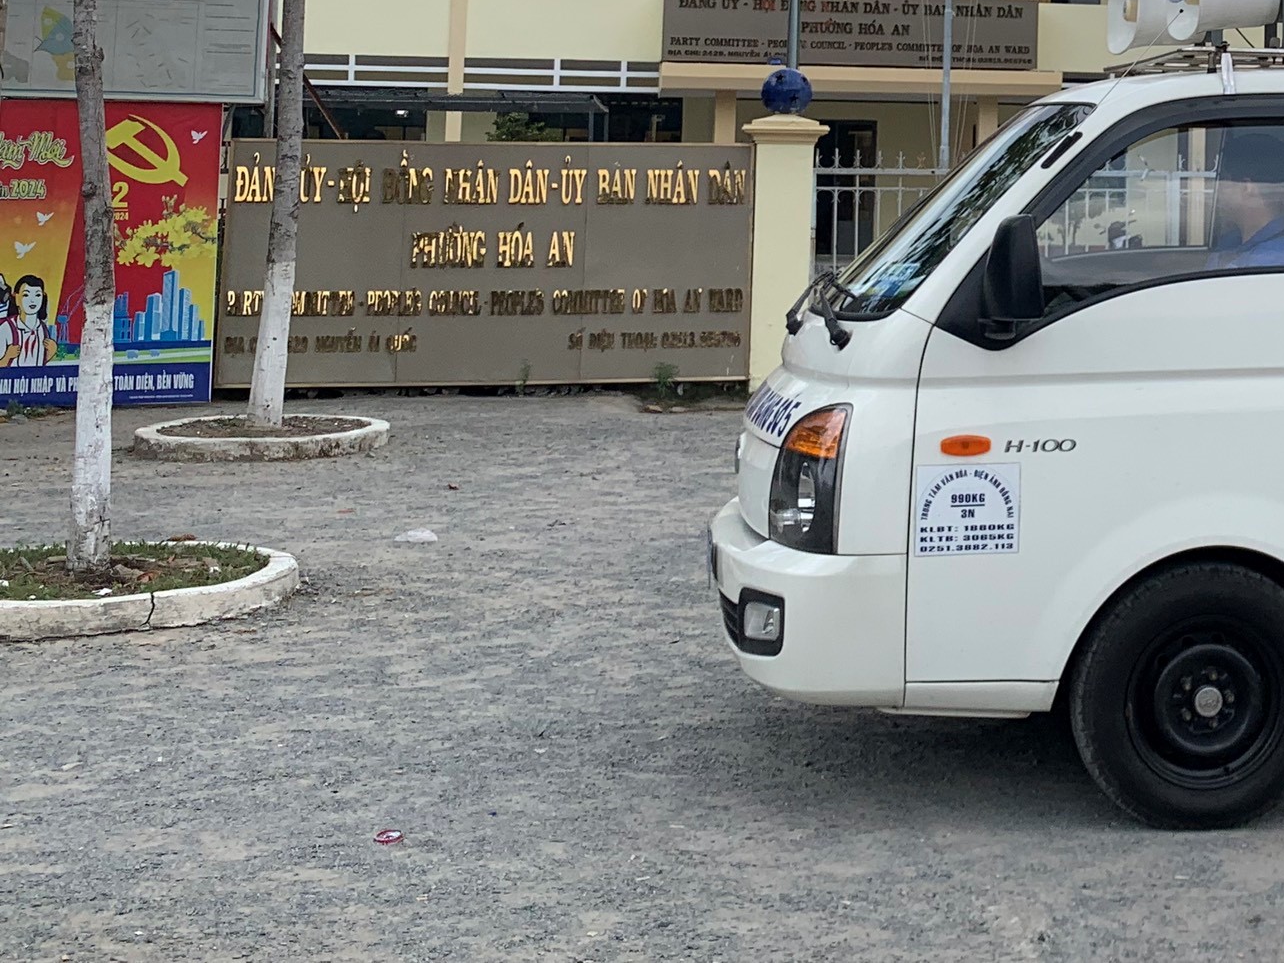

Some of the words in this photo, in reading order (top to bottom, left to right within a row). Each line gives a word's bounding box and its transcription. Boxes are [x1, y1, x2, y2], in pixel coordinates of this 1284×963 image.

[780, 0, 816, 13] ĐNG
[820, 0, 859, 13] NHÂN
[863, 0, 891, 15] DÂN
[902, 0, 919, 15] ỦY
[956, 4, 993, 18] NHÂN
[997, 6, 1024, 19] DÂN
[801, 18, 853, 34] PHƯỜNG
[858, 20, 885, 36] HÓA
[891, 24, 911, 36] AN
[670, 37, 700, 46] PARTY
[704, 38, 759, 48] COMMITTEE
[810, 41, 847, 50] COUNCIL
[1004, 46, 1030, 55] WARD
[234, 152, 276, 203] ĐẢN
[443, 159, 498, 205] NHÂN
[645, 160, 700, 204] NHÂN
[707, 161, 747, 205] DÂN
[10, 179, 46, 198] 2024
[497, 222, 535, 268] HÓA
[547, 231, 575, 268] AN
[30, 375, 54, 396] NHẬP
[56, 374, 67, 393] VÀ
[114, 373, 135, 391] TOÀN
[1004, 438, 1077, 453] H-100
[950, 493, 986, 503] 990KG
[961, 508, 976, 519] 3N
[962, 533, 1014, 542] 3065KG
